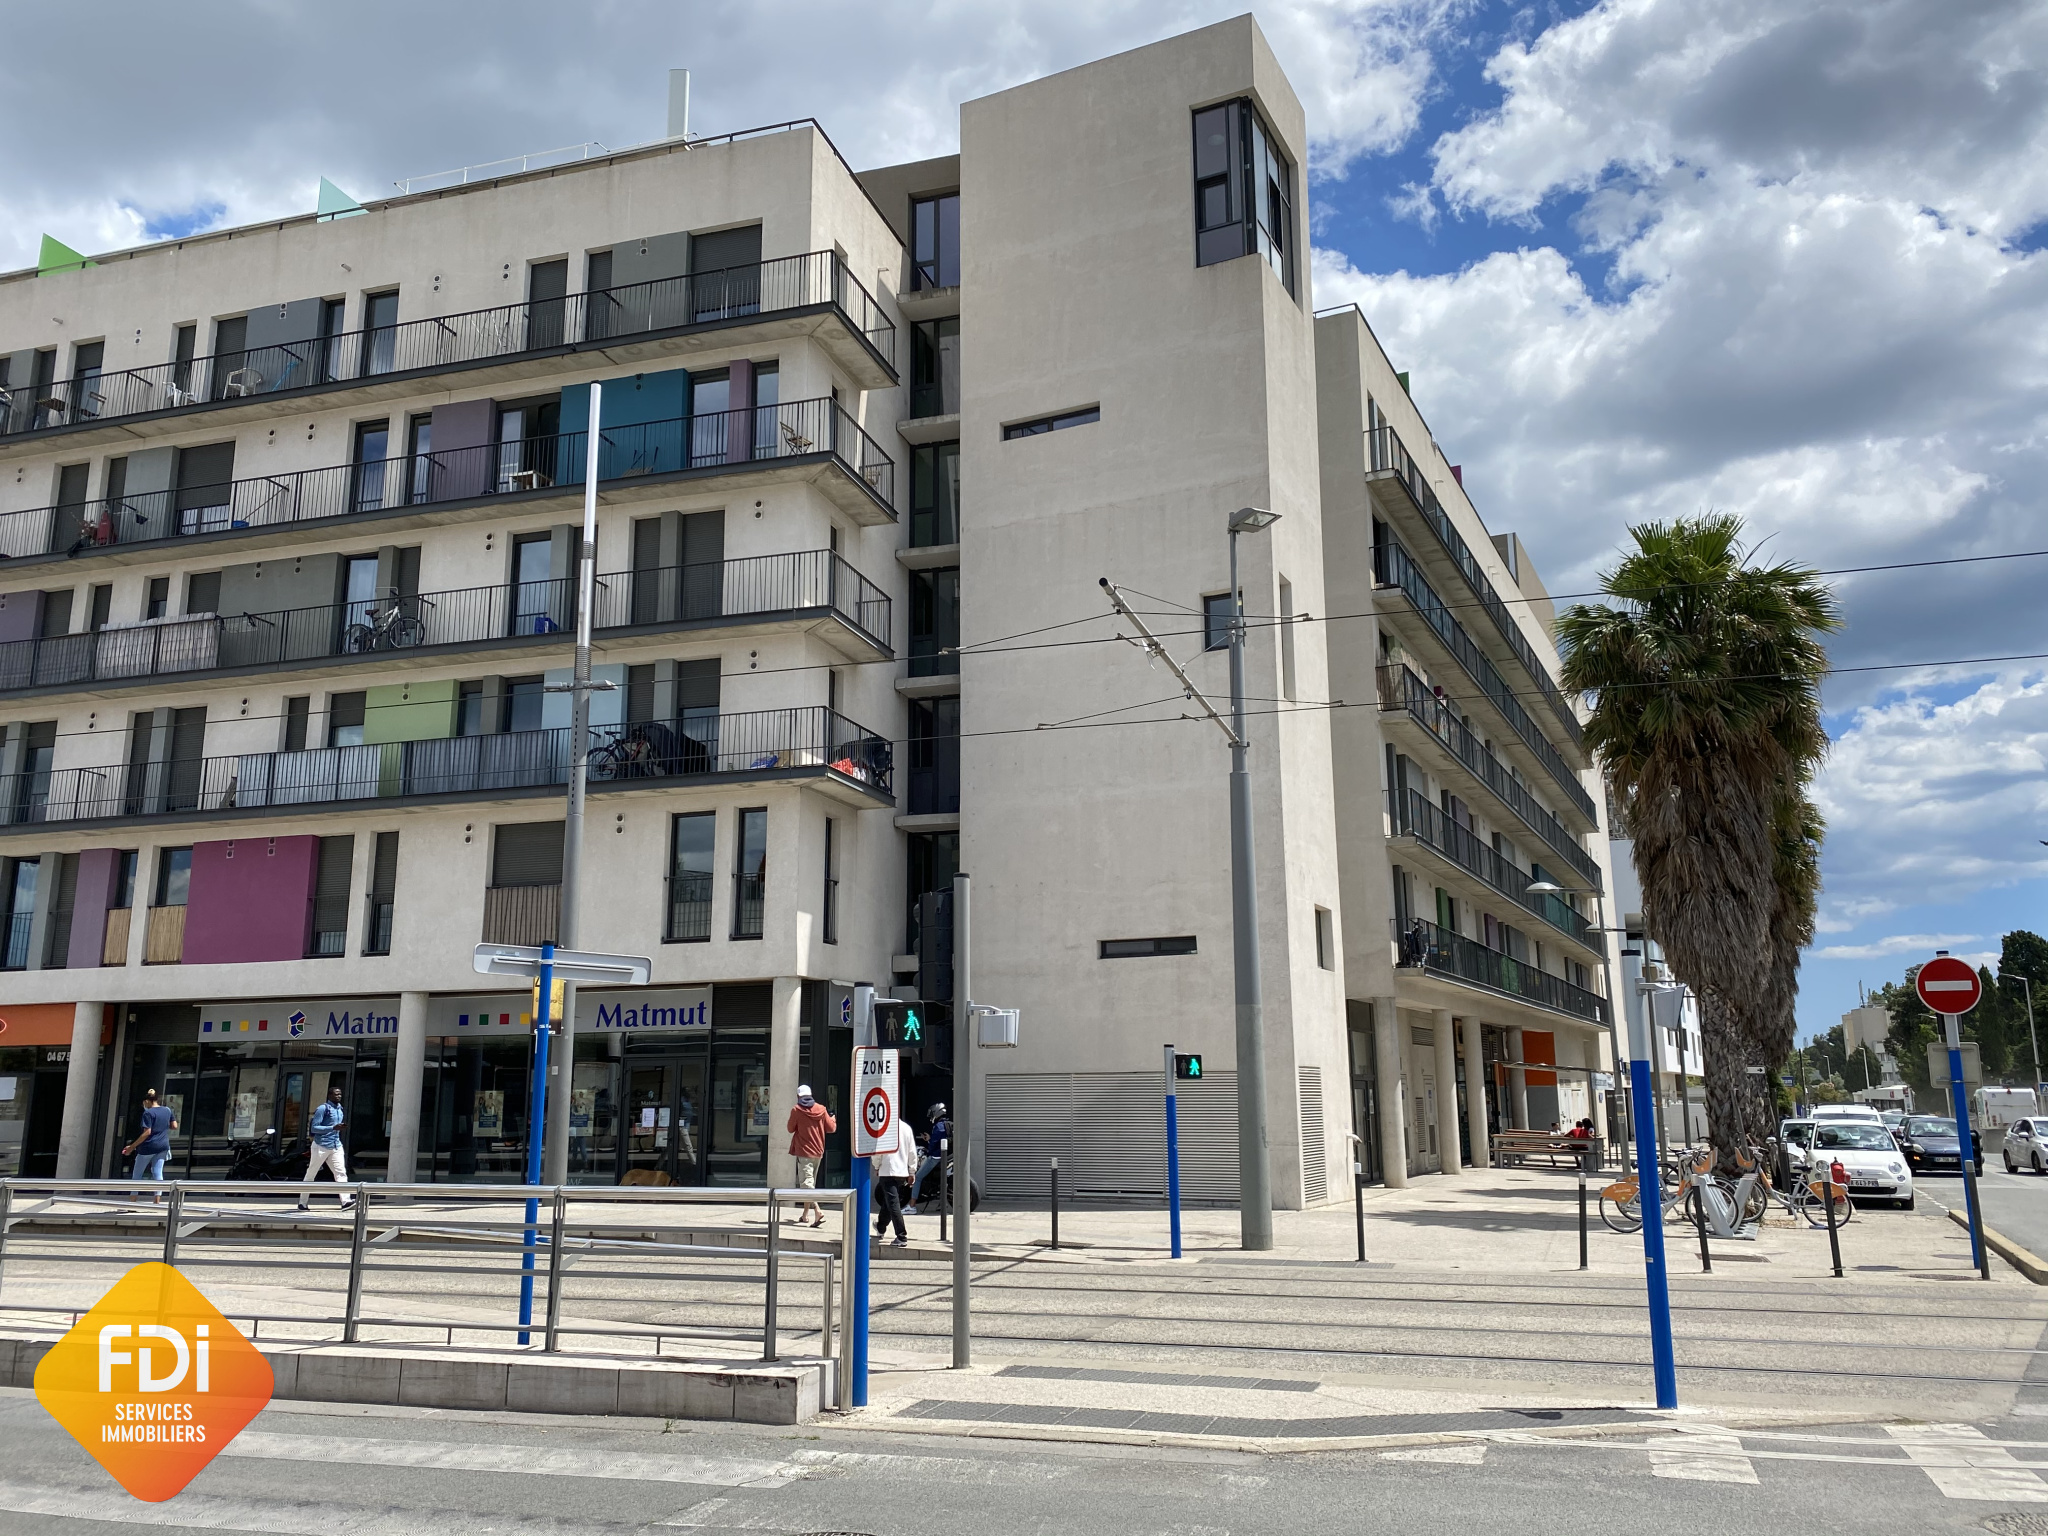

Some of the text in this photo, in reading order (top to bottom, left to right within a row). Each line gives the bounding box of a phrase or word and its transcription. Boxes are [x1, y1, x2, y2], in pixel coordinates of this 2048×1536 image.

[326, 1011, 398, 1035] Matm
[595, 1001, 707, 1029] Matmut
[57, 1052, 66, 1061] 67
[863, 1061, 891, 1075] ZONE
[868, 1102, 885, 1123] 30
